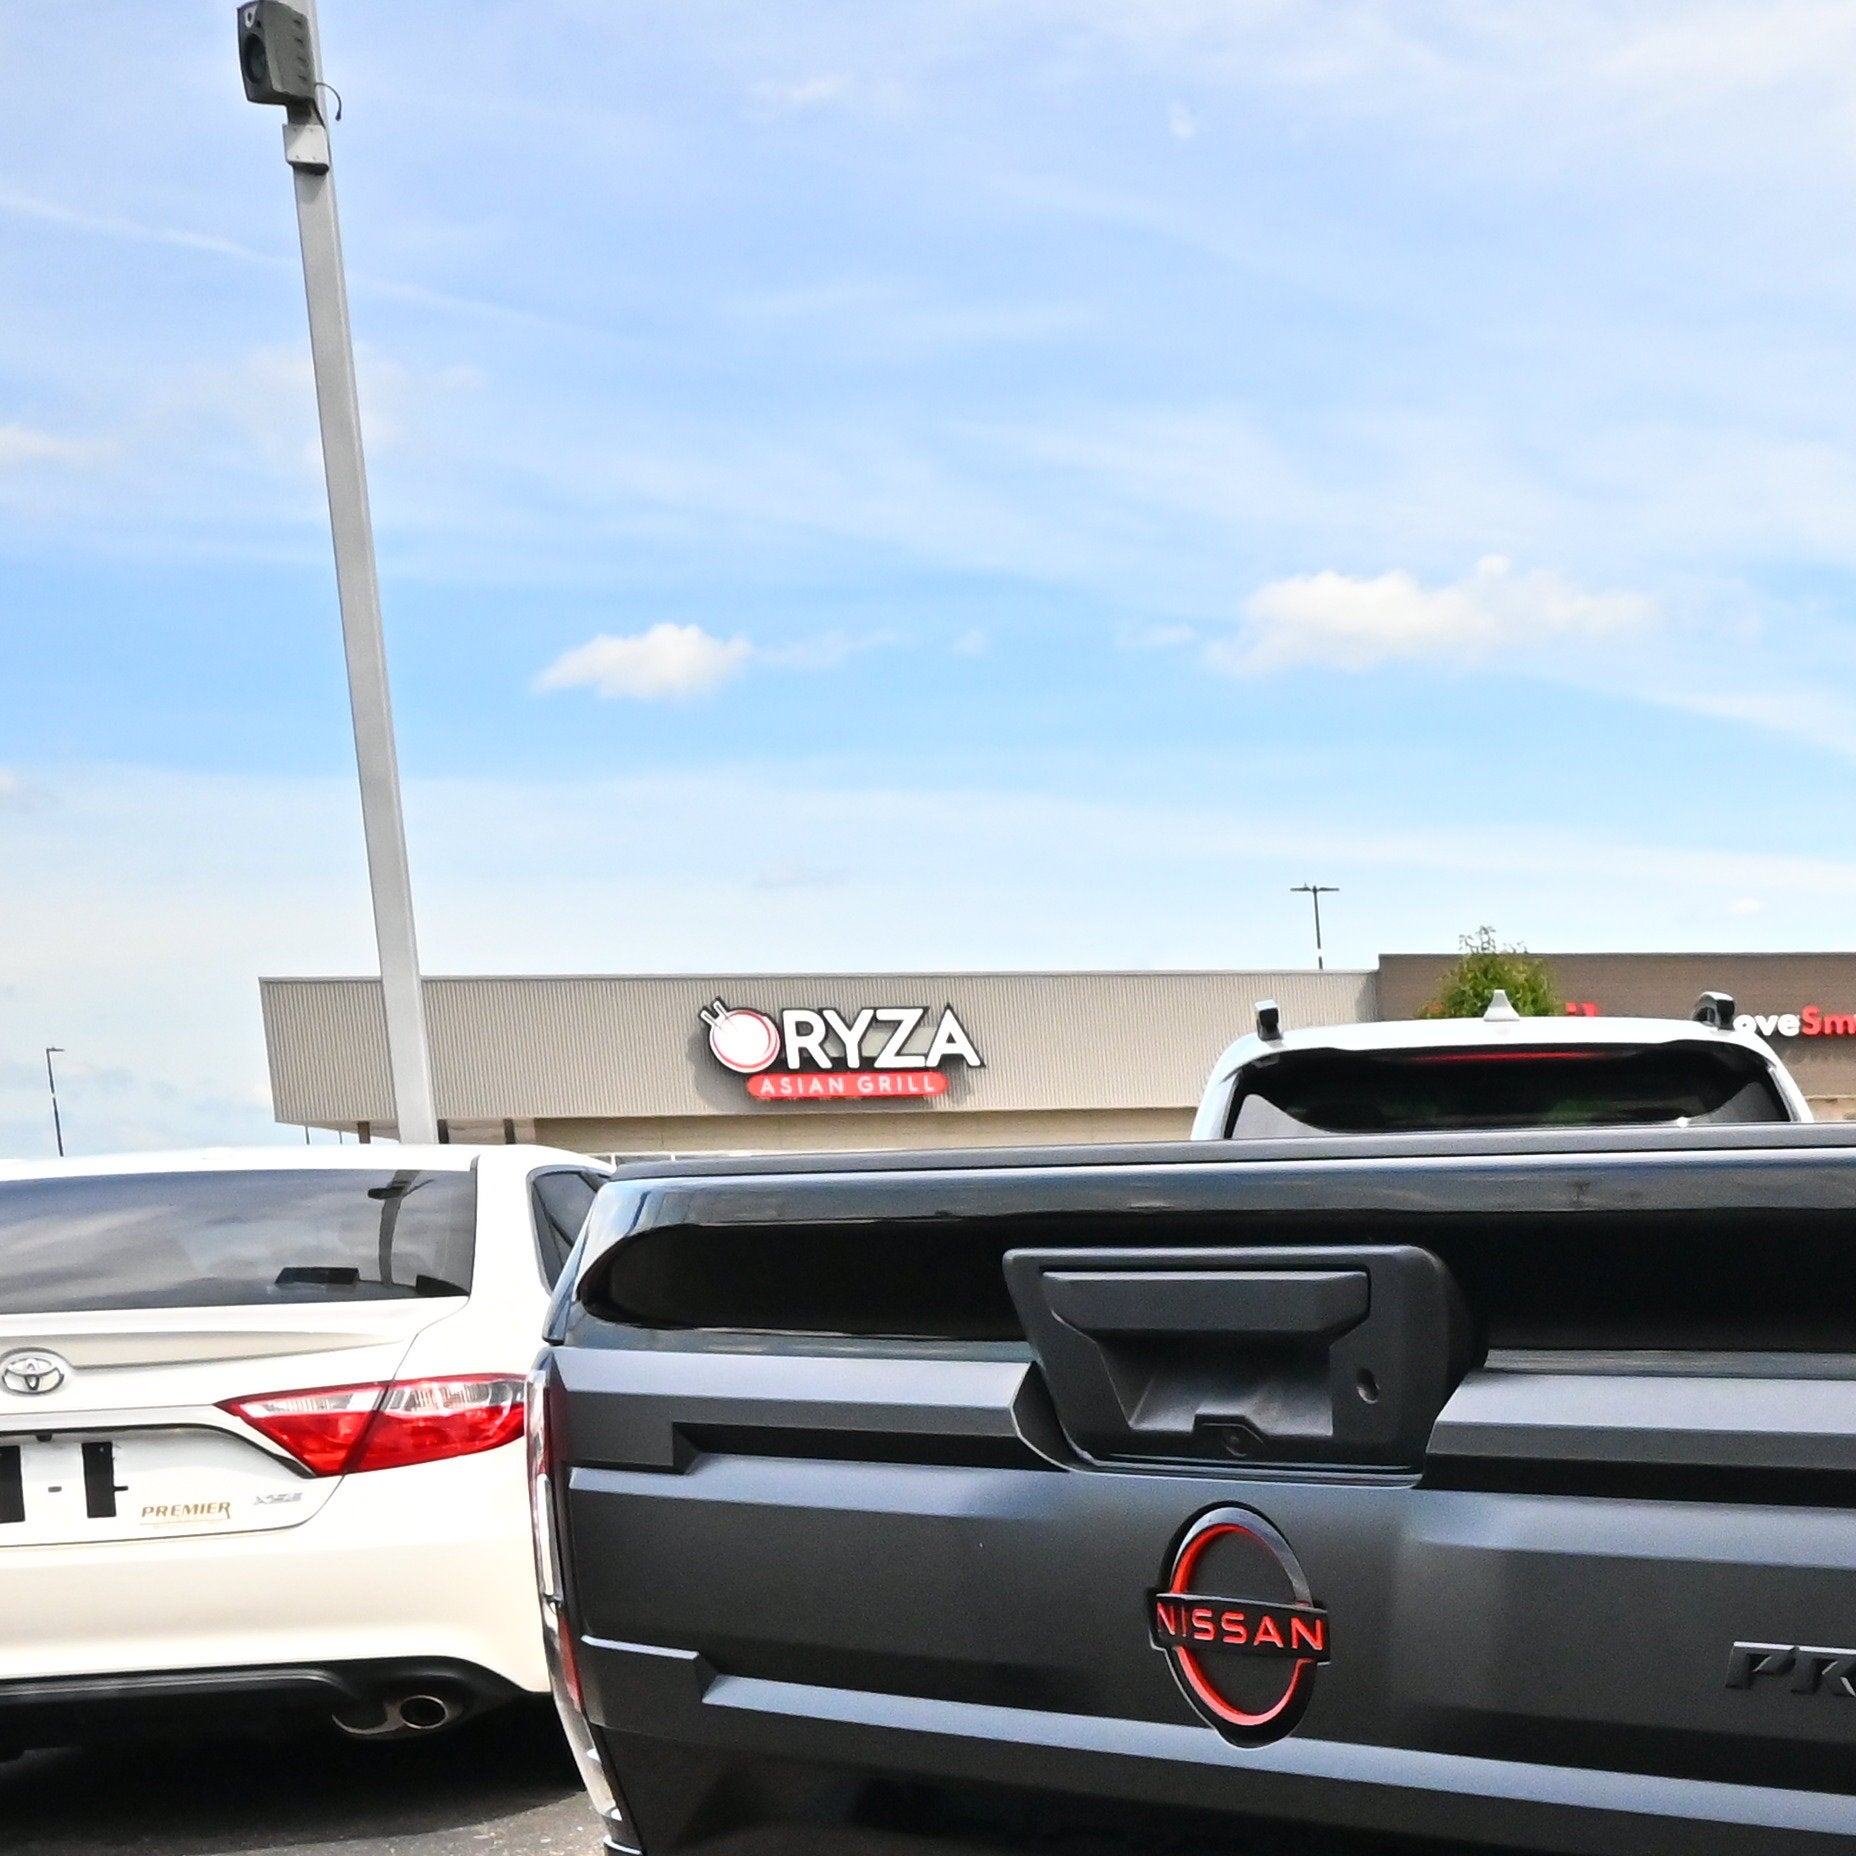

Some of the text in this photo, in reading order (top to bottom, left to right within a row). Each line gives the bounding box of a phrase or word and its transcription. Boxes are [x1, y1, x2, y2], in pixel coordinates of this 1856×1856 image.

[760, 1075, 936, 1094] ASIAN GRILL
[141, 1502, 231, 1519] PREMIER
[1157, 1601, 1324, 1651] NISSAN
